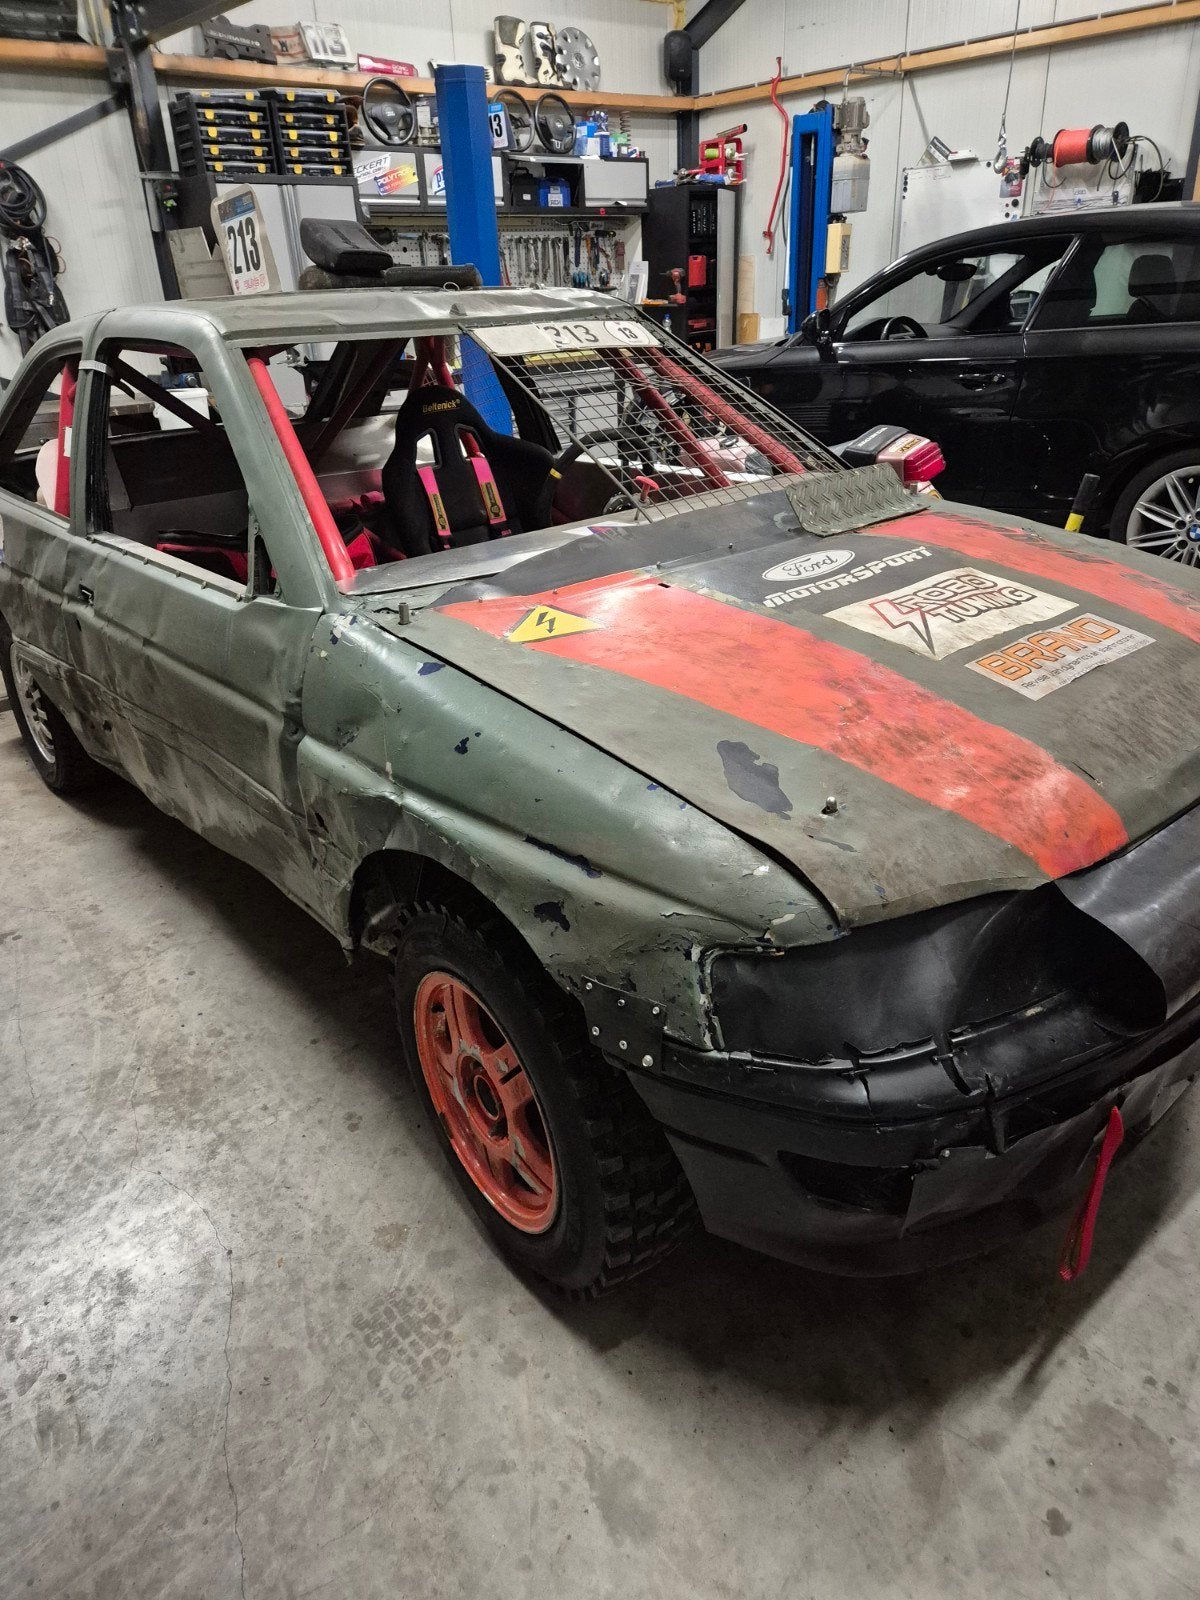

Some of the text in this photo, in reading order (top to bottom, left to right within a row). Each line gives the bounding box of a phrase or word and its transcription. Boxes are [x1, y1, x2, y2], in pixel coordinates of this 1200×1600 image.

[227, 216, 261, 275] 213
[617, 327, 639, 340] 13
[762, 546, 933, 608] MOTORSPORT
[782, 554, 838, 577] Ford
[928, 586, 1037, 624] TUNING
[975, 617, 1121, 682] BRAND
